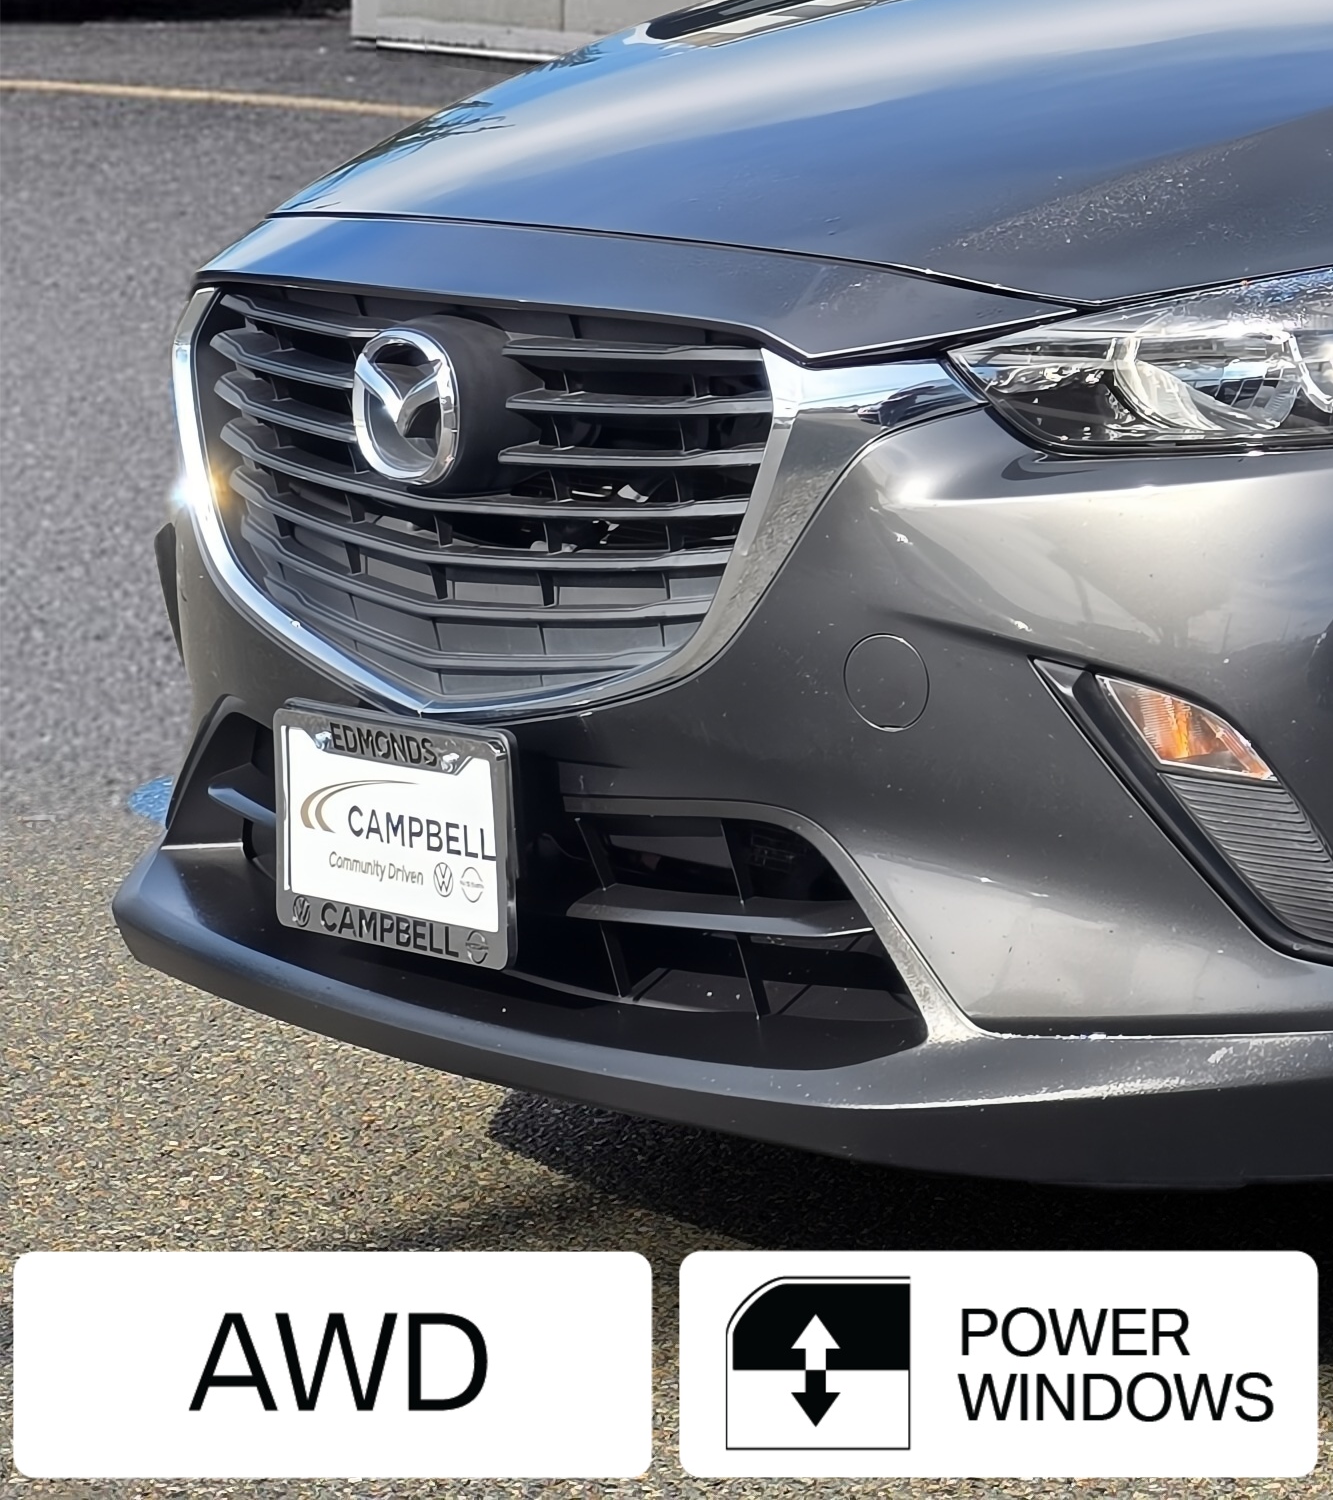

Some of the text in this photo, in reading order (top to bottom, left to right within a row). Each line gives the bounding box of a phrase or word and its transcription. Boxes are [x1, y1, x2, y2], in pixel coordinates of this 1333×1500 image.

[330, 722, 438, 766] EDMONDS
[348, 805, 497, 861] CAMPBELL
[329, 851, 424, 885] Community Driven
[321, 902, 459, 958] CAMPBELL
